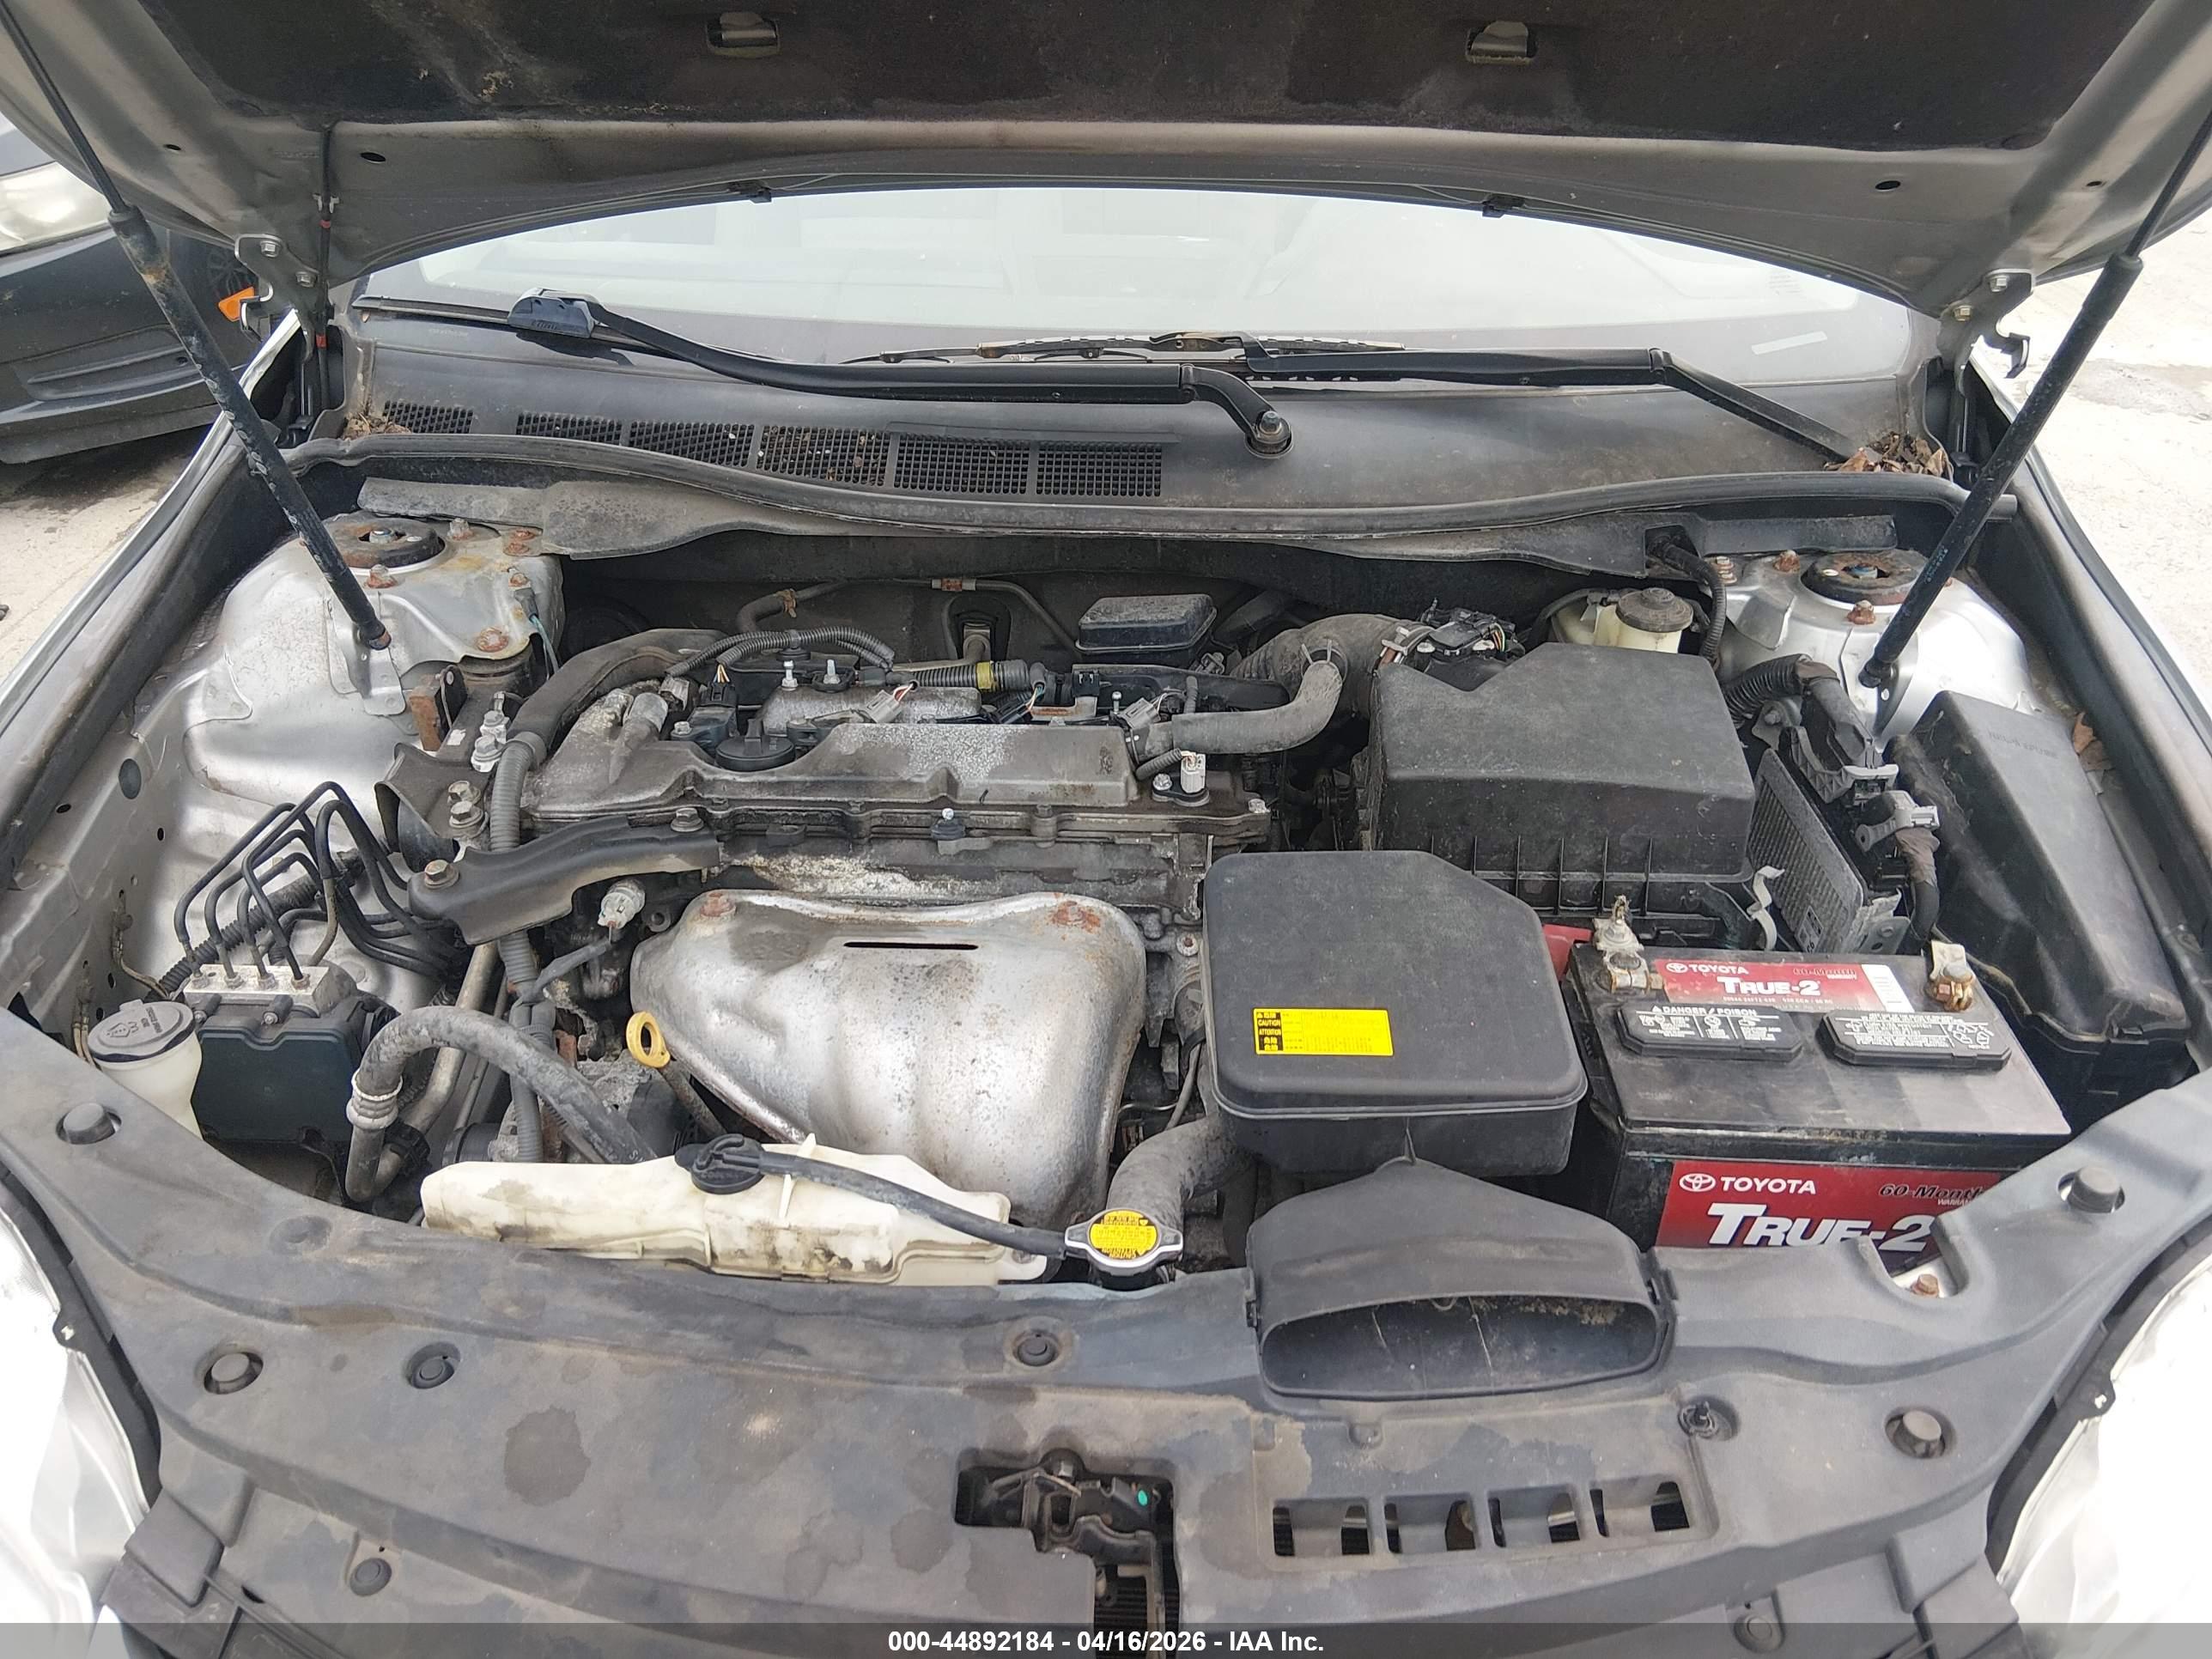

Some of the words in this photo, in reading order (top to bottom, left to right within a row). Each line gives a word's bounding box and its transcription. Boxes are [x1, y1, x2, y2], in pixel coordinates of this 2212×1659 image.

[1688, 963, 1749, 975] TOYOTA
[1717, 976, 1820, 996] TRUE-2
[1662, 1006, 1706, 1015] DANGER
[1720, 1176, 1817, 1194] TOYOTA
[1707, 1202, 1936, 1253] TRUE-2
